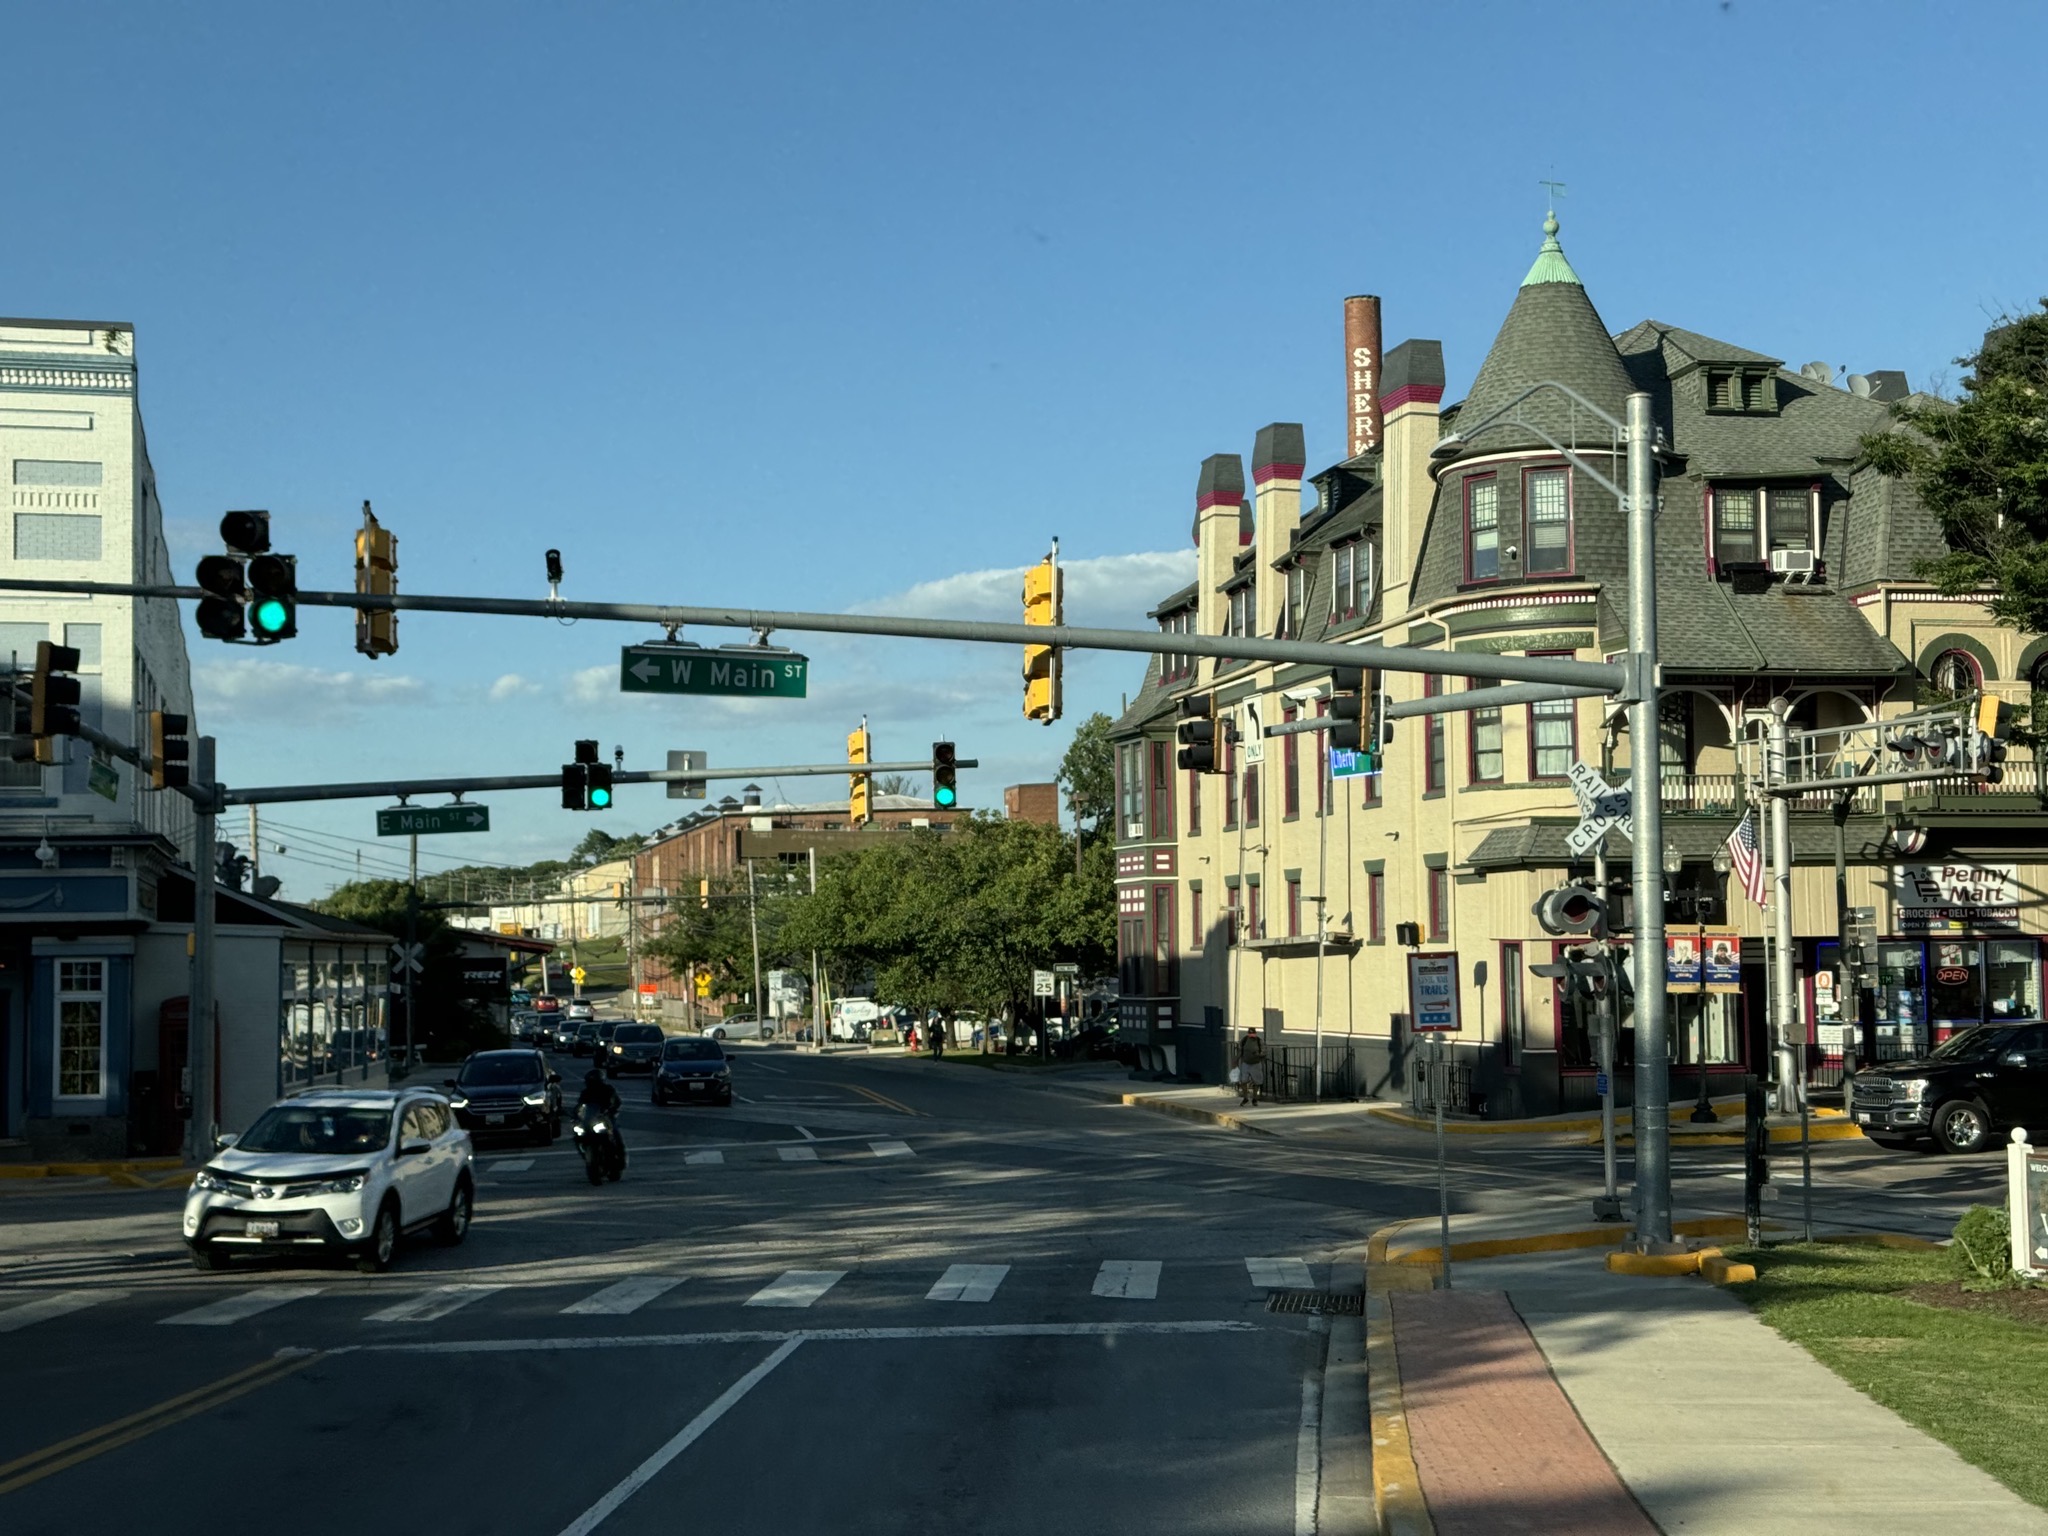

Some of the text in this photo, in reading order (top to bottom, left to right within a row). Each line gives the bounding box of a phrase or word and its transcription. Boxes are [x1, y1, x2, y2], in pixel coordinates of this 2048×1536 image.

[671, 659, 803, 689] W Main ST
[1247, 743, 1262, 758] ONLY
[1333, 749, 1355, 771] Liberty
[1571, 763, 1607, 804] RAIL
[380, 812, 460, 831] E Main ST
[1941, 866, 2011, 885] Penny
[1949, 886, 2005, 902] Mart
[1900, 907, 2017, 919] GROCERY DELI TOBACCO
[462, 970, 503, 979] TREK
[1936, 969, 1969, 981] OPEN
[1036, 983, 1052, 993] 25
[1419, 984, 1449, 996] TRAILS
